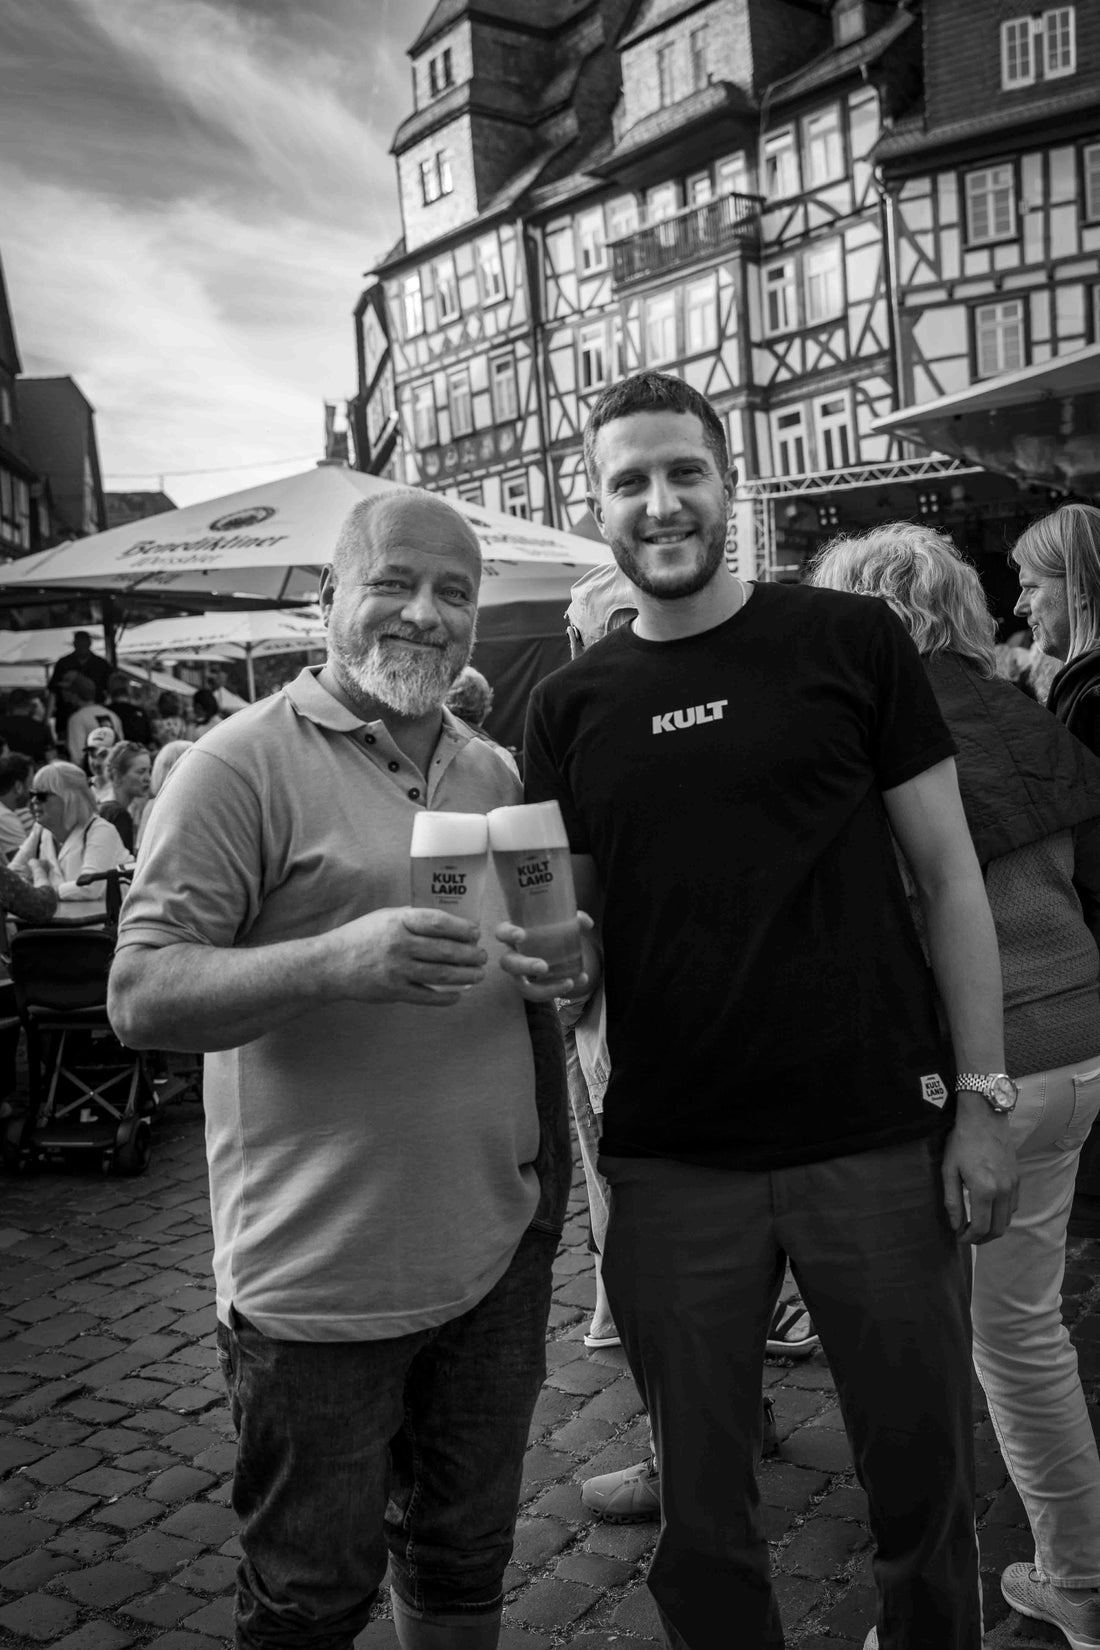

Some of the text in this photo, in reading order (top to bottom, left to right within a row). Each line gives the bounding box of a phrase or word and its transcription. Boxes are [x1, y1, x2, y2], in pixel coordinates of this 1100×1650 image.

[652, 699, 728, 735] KULT
[517, 860, 550, 876] KULT
[432, 872, 467, 883] KULT
[518, 872, 554, 888] LAND
[431, 883, 468, 895] LAND
[926, 1080, 940, 1089] KULT
[926, 1087, 944, 1096] LAND
